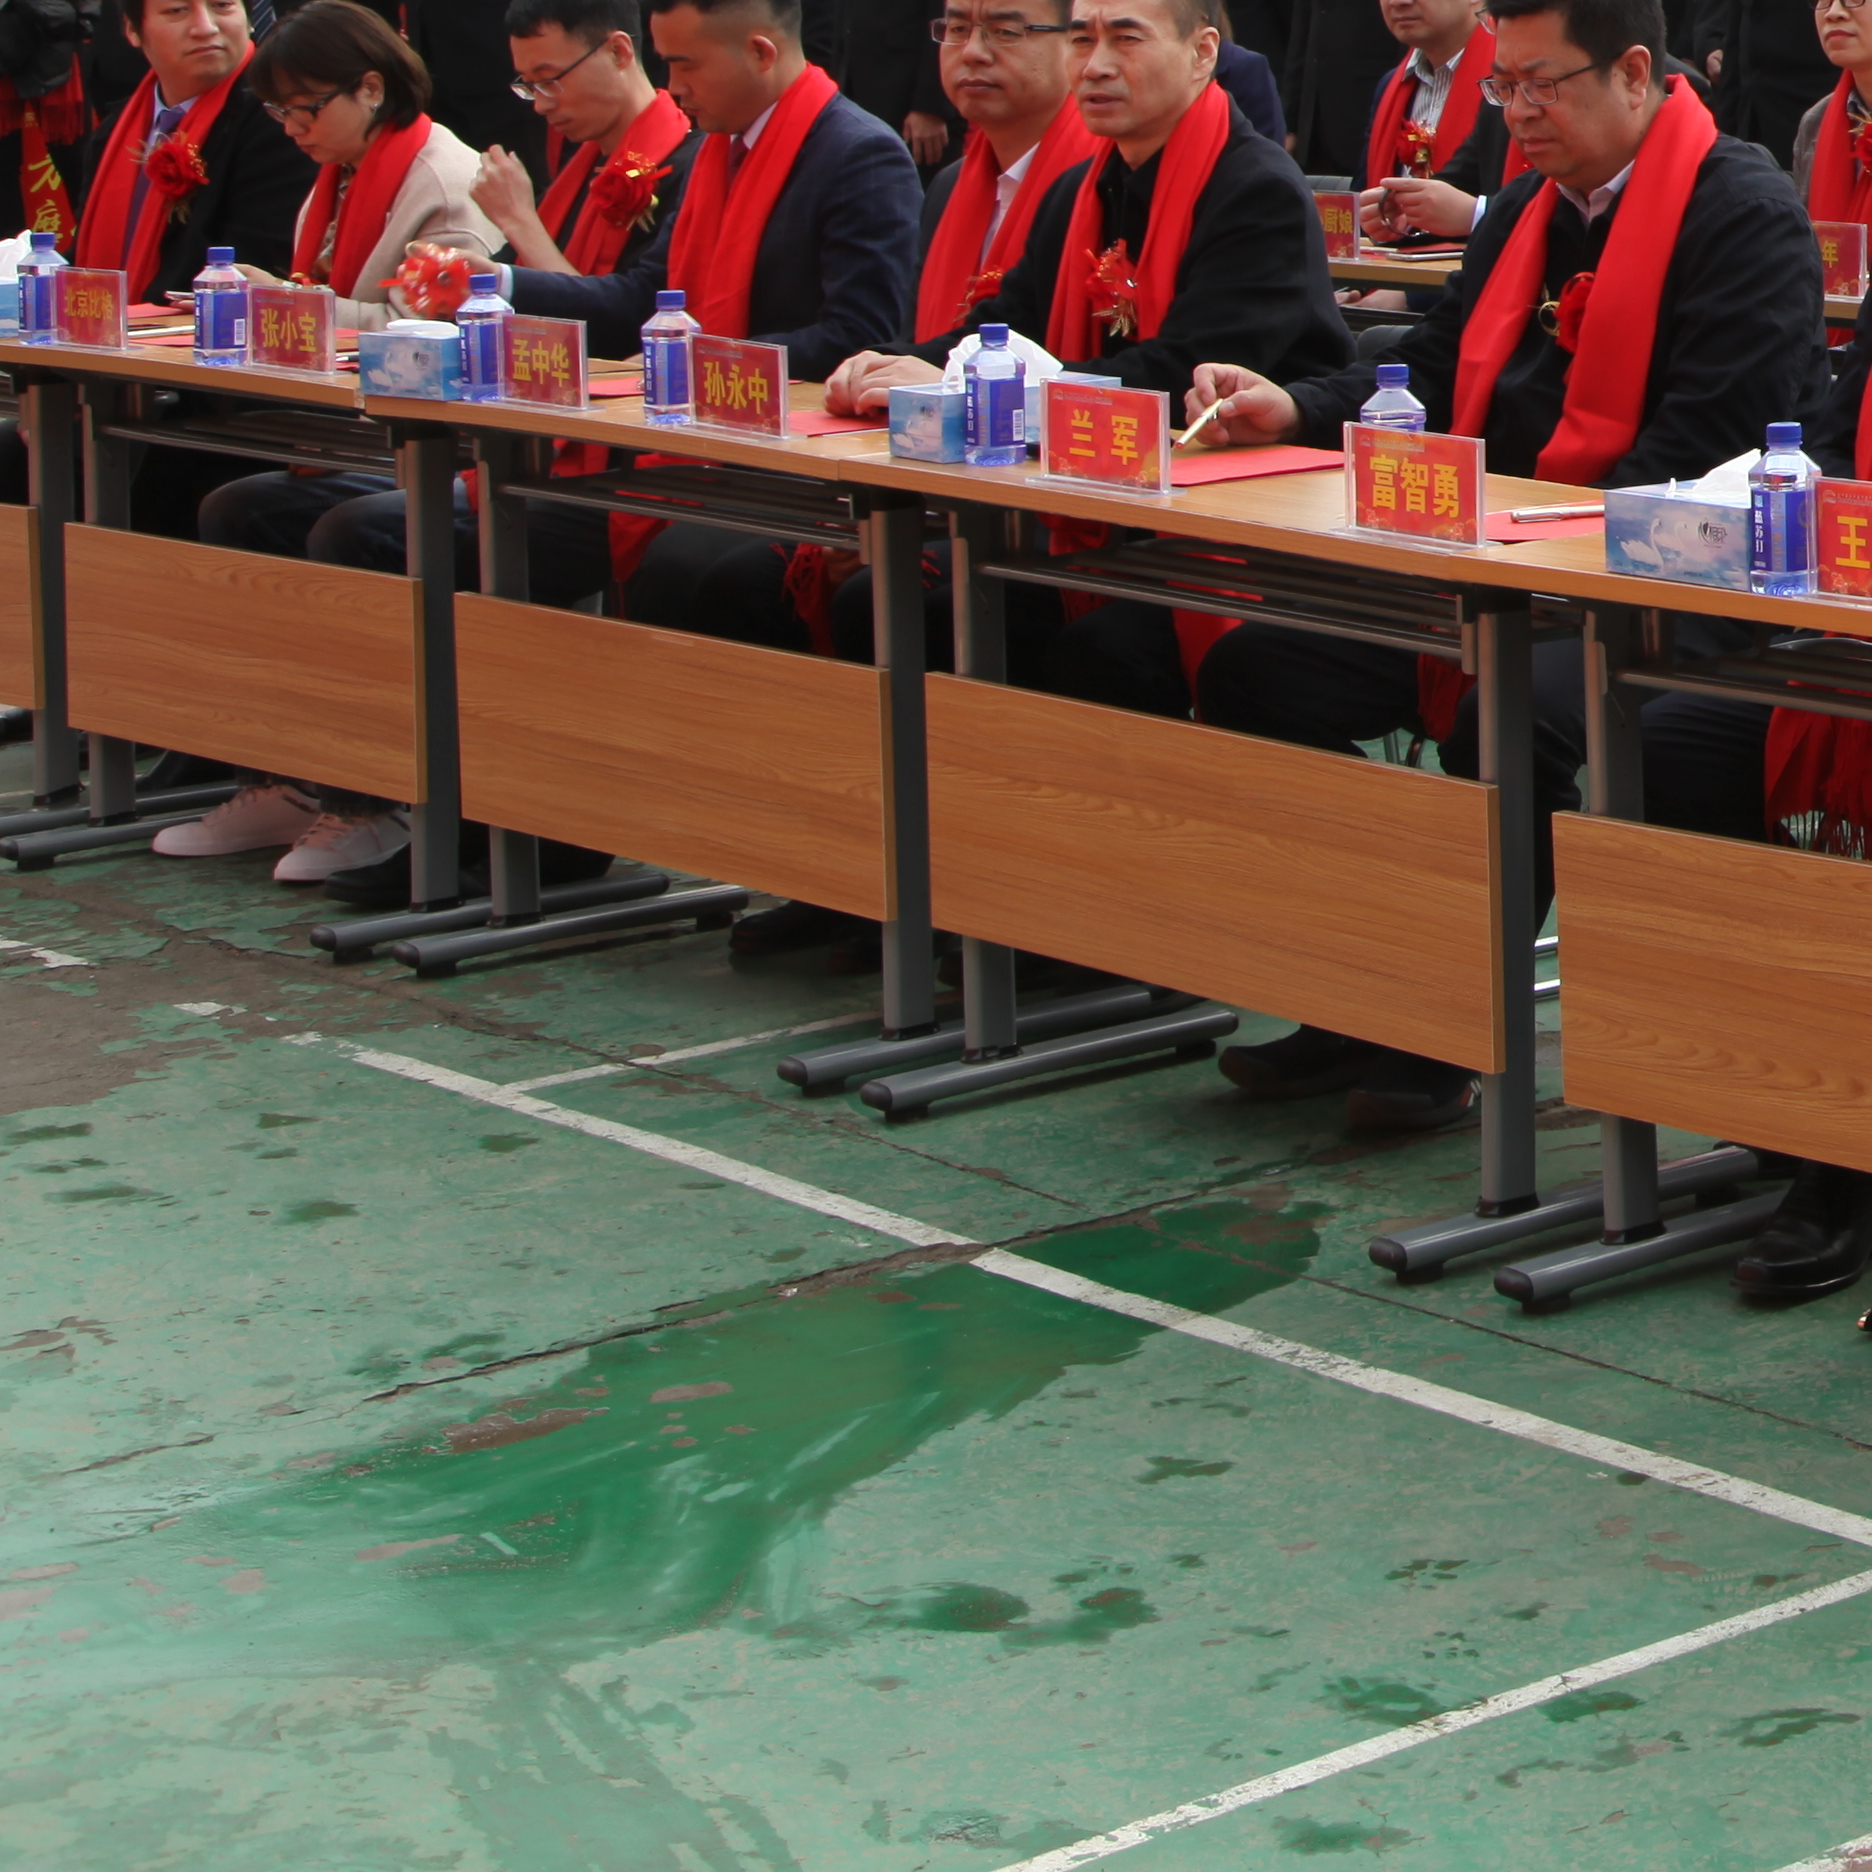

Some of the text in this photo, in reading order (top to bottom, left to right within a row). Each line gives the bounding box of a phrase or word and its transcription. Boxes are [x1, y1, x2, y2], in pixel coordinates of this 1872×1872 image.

[260, 308, 318, 354] 张小宝
[511, 339, 570, 388] 孟中华
[703, 360, 769, 415] 孙永中
[1068, 407, 1139, 466] 兰军
[1369, 453, 1460, 519] 富智勇
